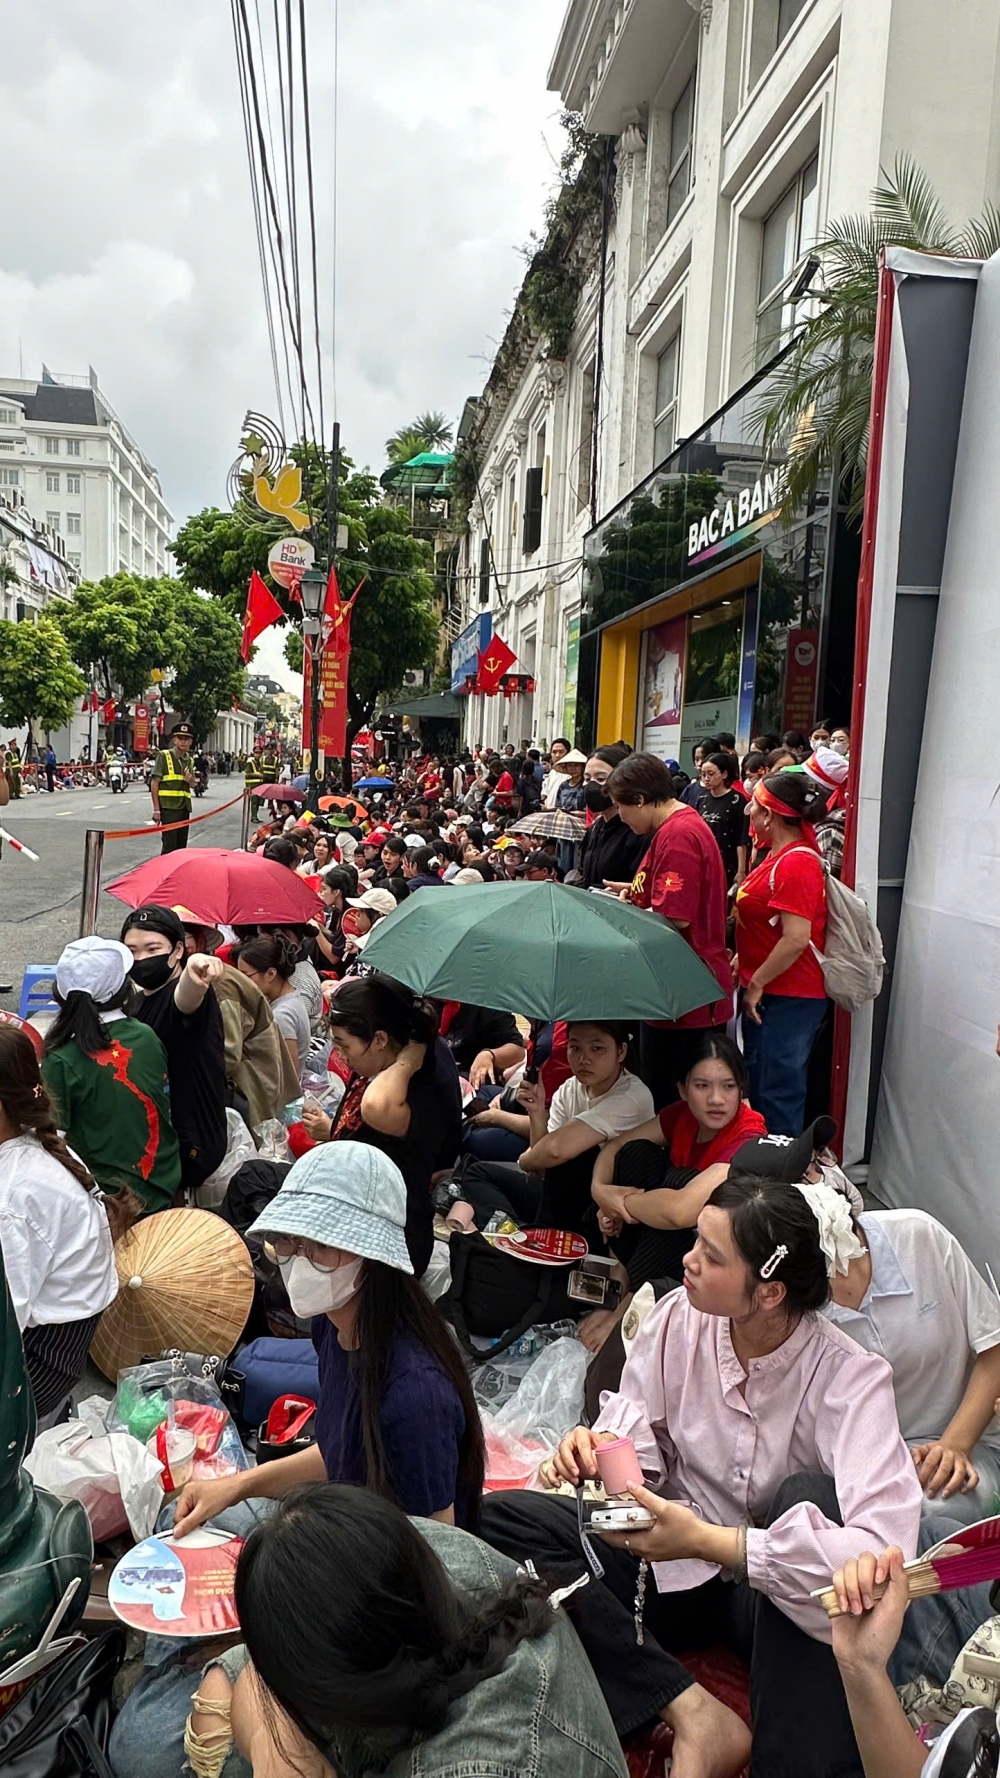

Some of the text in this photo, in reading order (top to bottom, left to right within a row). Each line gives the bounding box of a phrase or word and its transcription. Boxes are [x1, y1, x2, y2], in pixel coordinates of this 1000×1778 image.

[687, 509, 720, 557] BAC
[721, 500, 734, 537] A
[281, 543, 298, 554] HD
[280, 552, 306, 566] Bank
